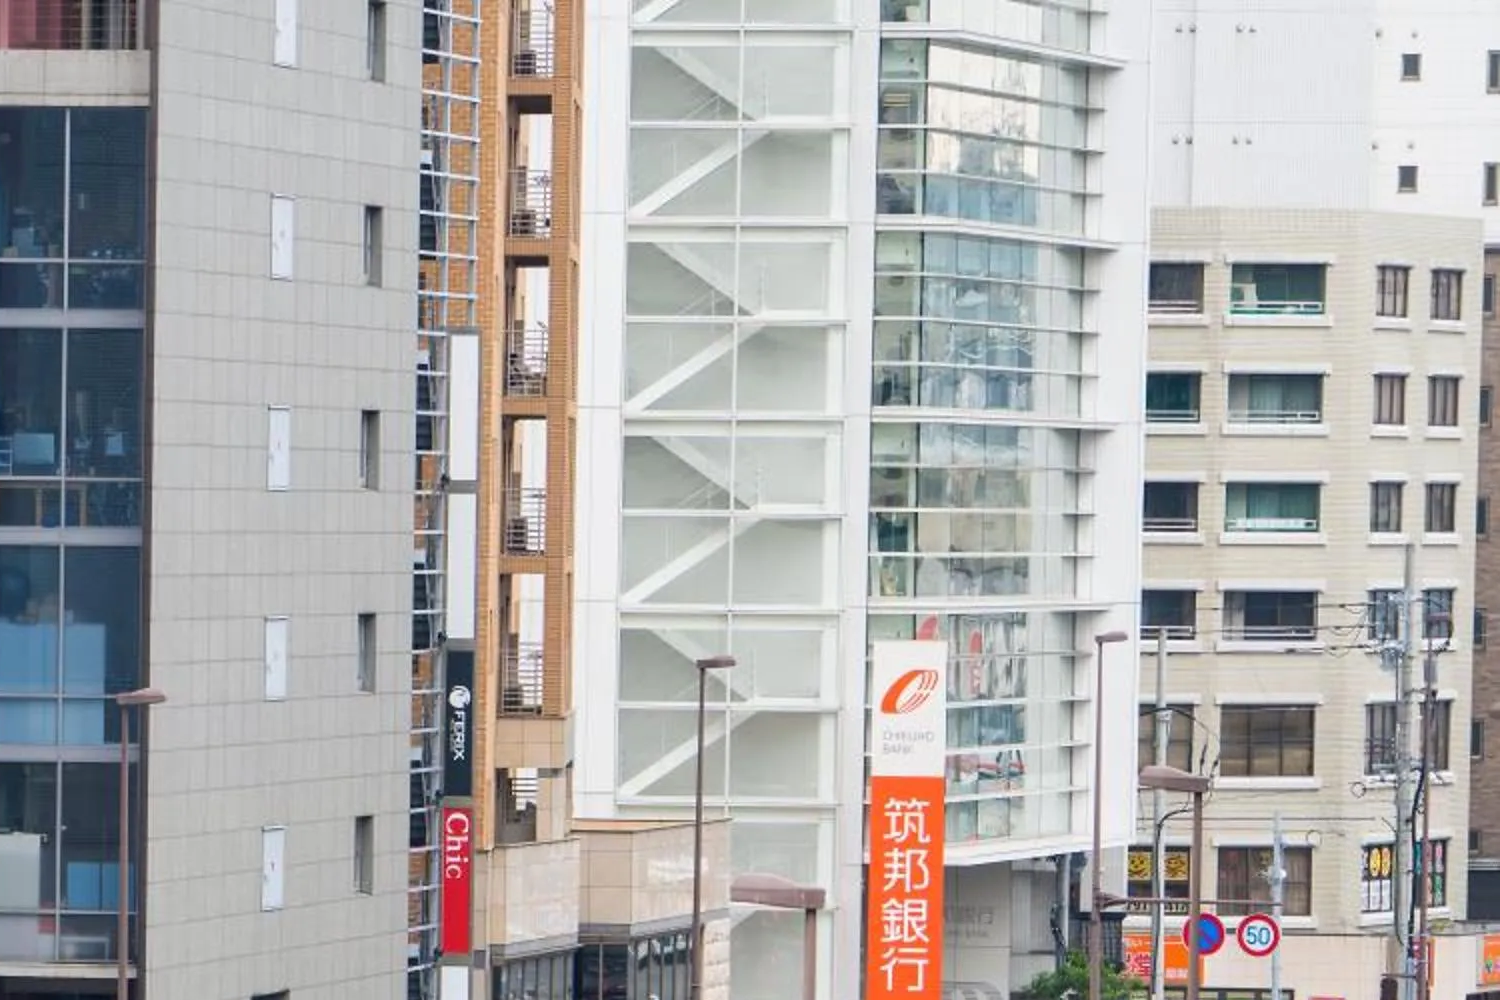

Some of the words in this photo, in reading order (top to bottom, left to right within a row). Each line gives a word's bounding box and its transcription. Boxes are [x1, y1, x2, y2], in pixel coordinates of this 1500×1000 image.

[445, 812, 469, 879] Chic
[880, 797, 932, 992] 筑邦銀行
[1246, 925, 1271, 946] 50
